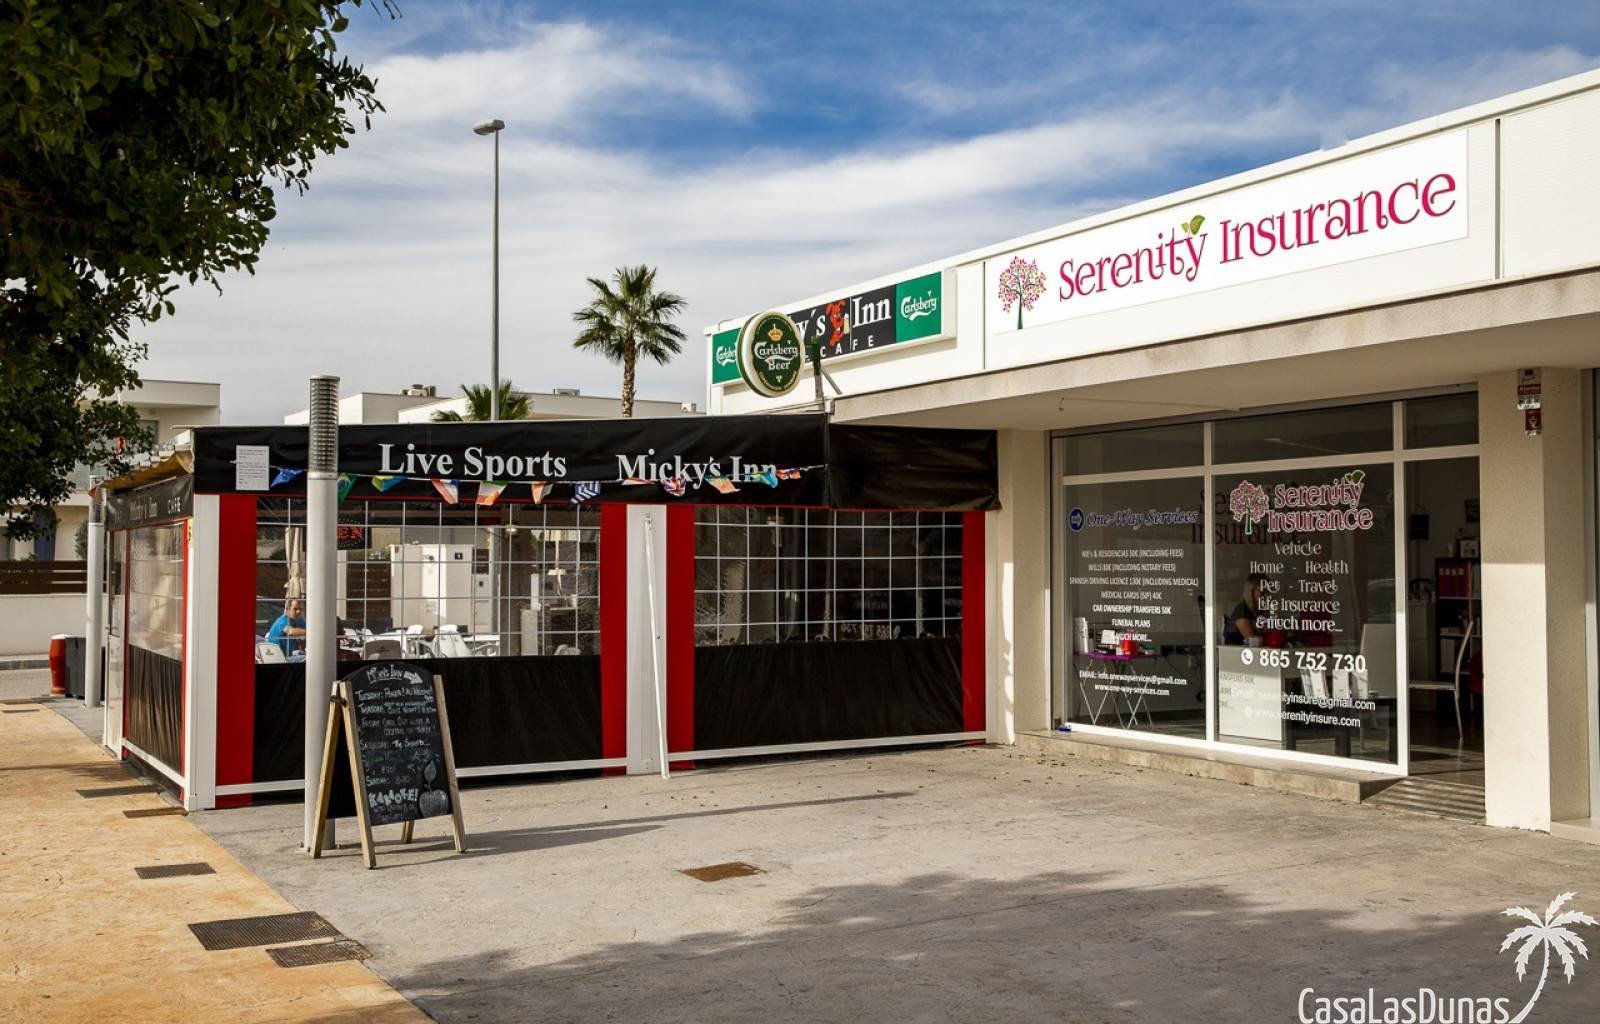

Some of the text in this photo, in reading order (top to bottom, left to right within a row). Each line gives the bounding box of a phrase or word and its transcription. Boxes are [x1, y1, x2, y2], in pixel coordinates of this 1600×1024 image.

[1058, 172, 1457, 302] Serenity Insurance
[852, 297, 892, 328] Inn
[901, 291, 938, 321] Carlsberg
[754, 340, 798, 361] Carlsberg
[768, 359, 791, 371] Beer
[378, 443, 567, 481] Live Sports
[615, 448, 778, 490] Micky's Inn
[1274, 479, 1364, 509] Serenity
[1088, 507, 1199, 531] One-Way Services
[1266, 507, 1375, 533] Insurance
[1274, 540, 1322, 555] Vehicle
[1249, 560, 1284, 574] Home
[1305, 559, 1349, 574] Health
[1173, 577, 1199, 587] MEDICAL)
[1297, 579, 1339, 595] Travel
[1123, 591, 1140, 600] CARDS
[1258, 596, 1341, 614] Life Insurance
[1103, 605, 1133, 614] OWNERSHIP
[1133, 605, 1161, 614] TRANSFERS
[1111, 619, 1151, 628] FUNERAL PLANS
[1259, 649, 1366, 673] 865 752 730
[1079, 669, 1098, 679] EMAIL:
